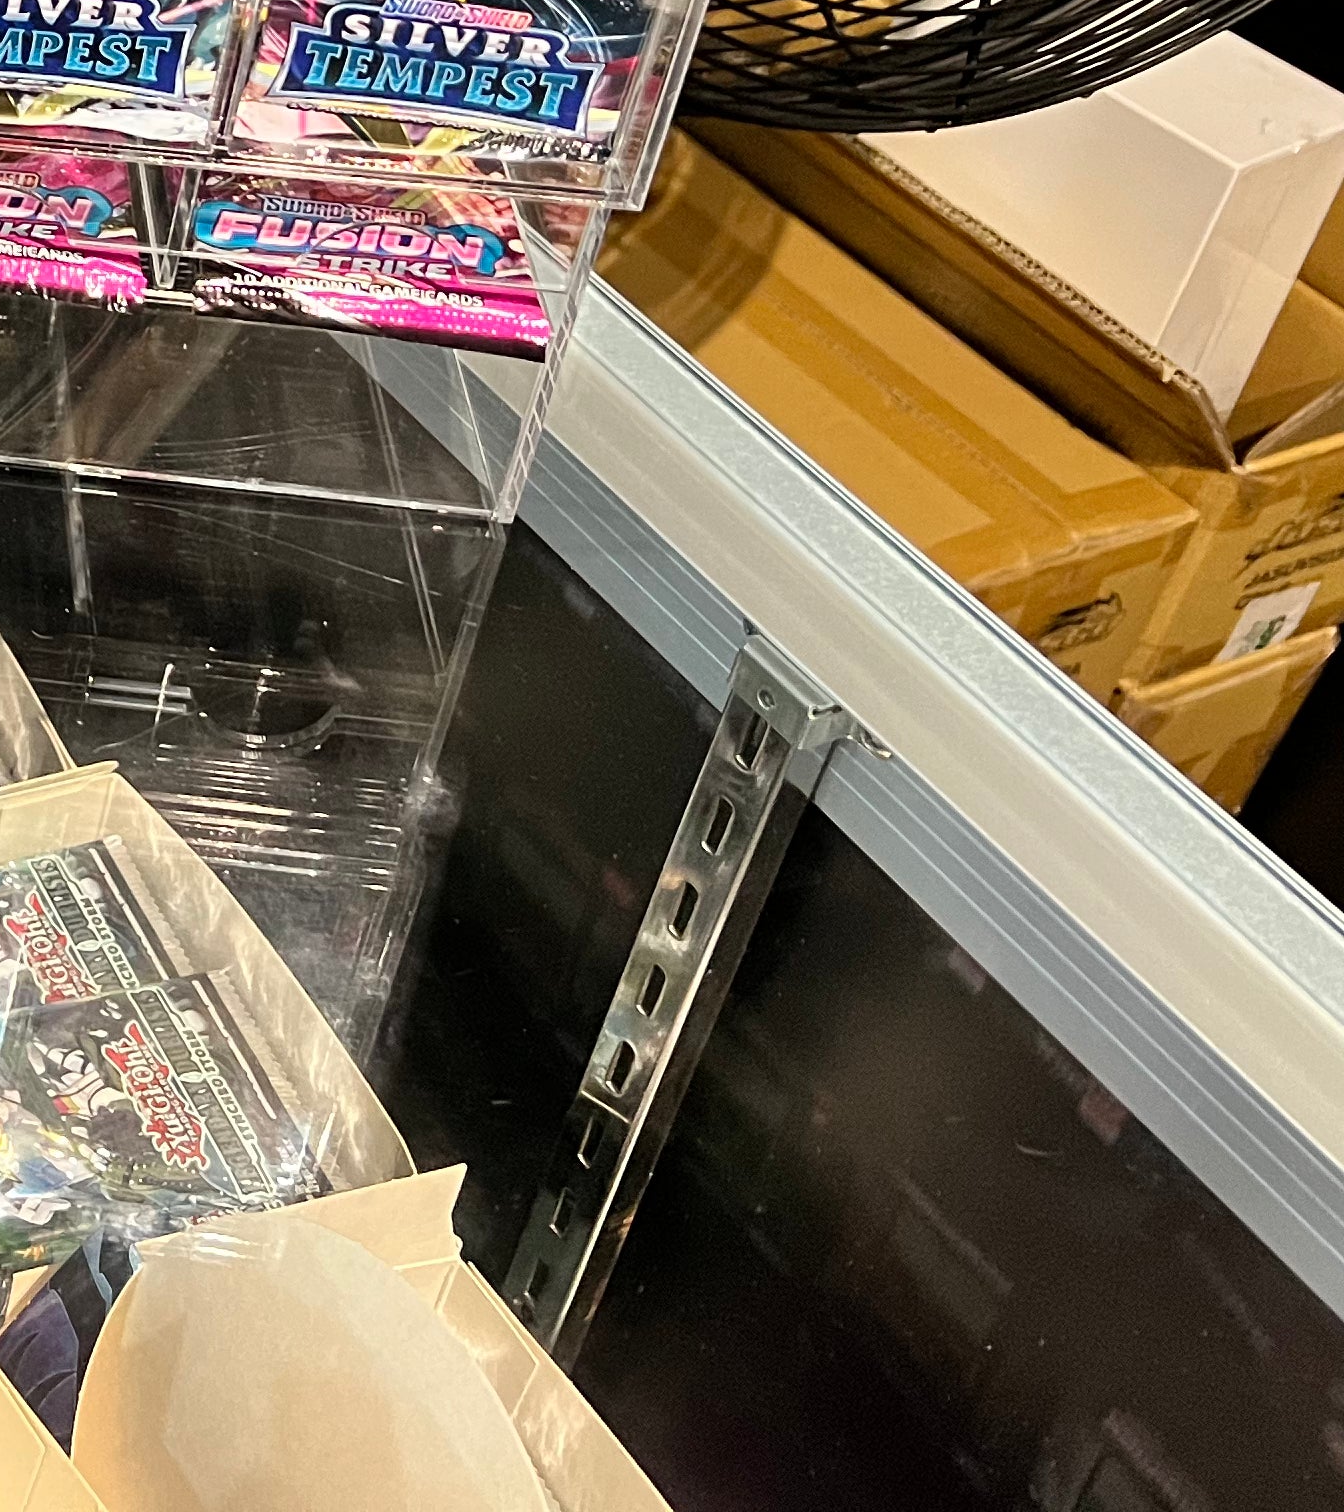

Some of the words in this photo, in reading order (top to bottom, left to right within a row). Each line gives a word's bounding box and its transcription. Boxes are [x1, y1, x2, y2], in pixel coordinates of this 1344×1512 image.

[340, 13, 552, 66] SILVER
[300, 39, 577, 120] TEMPEST
[212, 213, 483, 263] FUSION
[233, 273, 253, 285] 10
[260, 275, 364, 293] ADDITIONAL
[299, 253, 452, 279] STRIKE
[30, 854, 95, 946] DUELISTS
[79, 895, 111, 941] STORM
